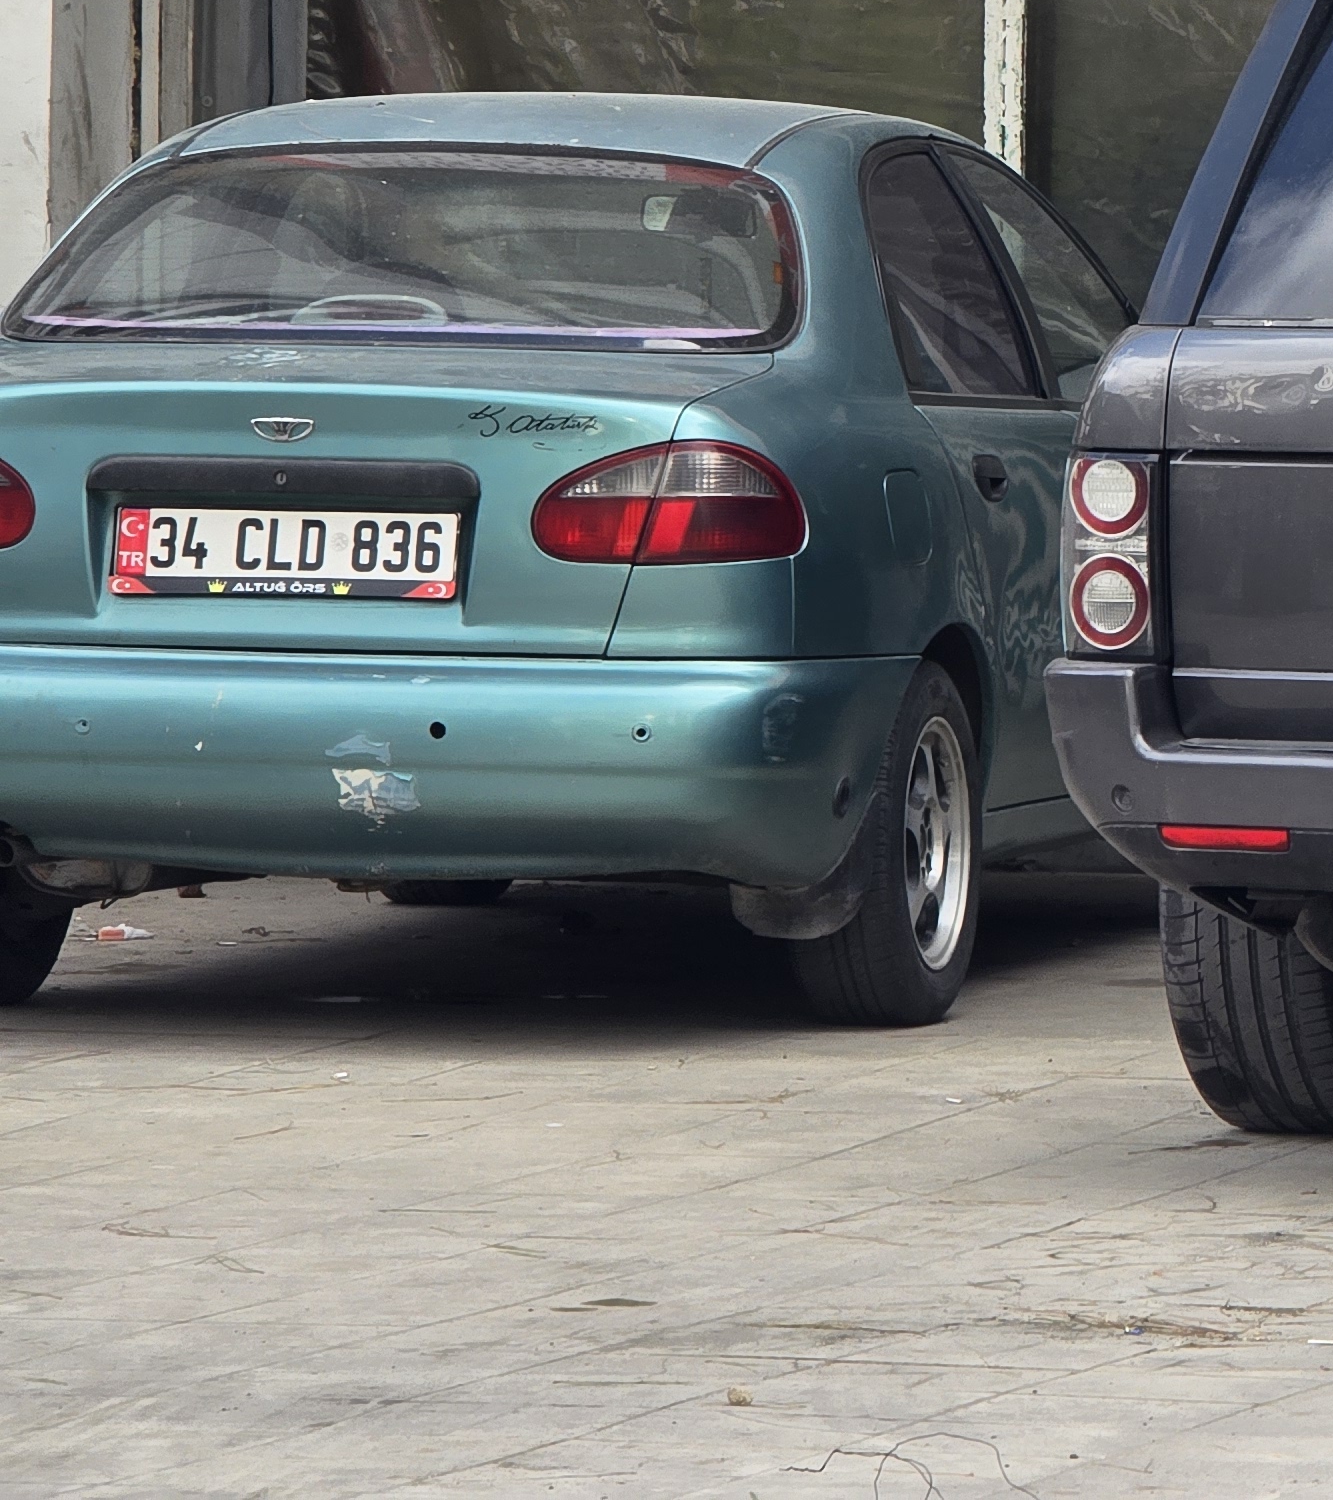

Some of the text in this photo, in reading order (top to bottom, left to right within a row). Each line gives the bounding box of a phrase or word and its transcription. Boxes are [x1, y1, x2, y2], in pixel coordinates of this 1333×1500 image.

[118, 551, 144, 568] TR
[150, 516, 443, 574] 34 CLD 836
